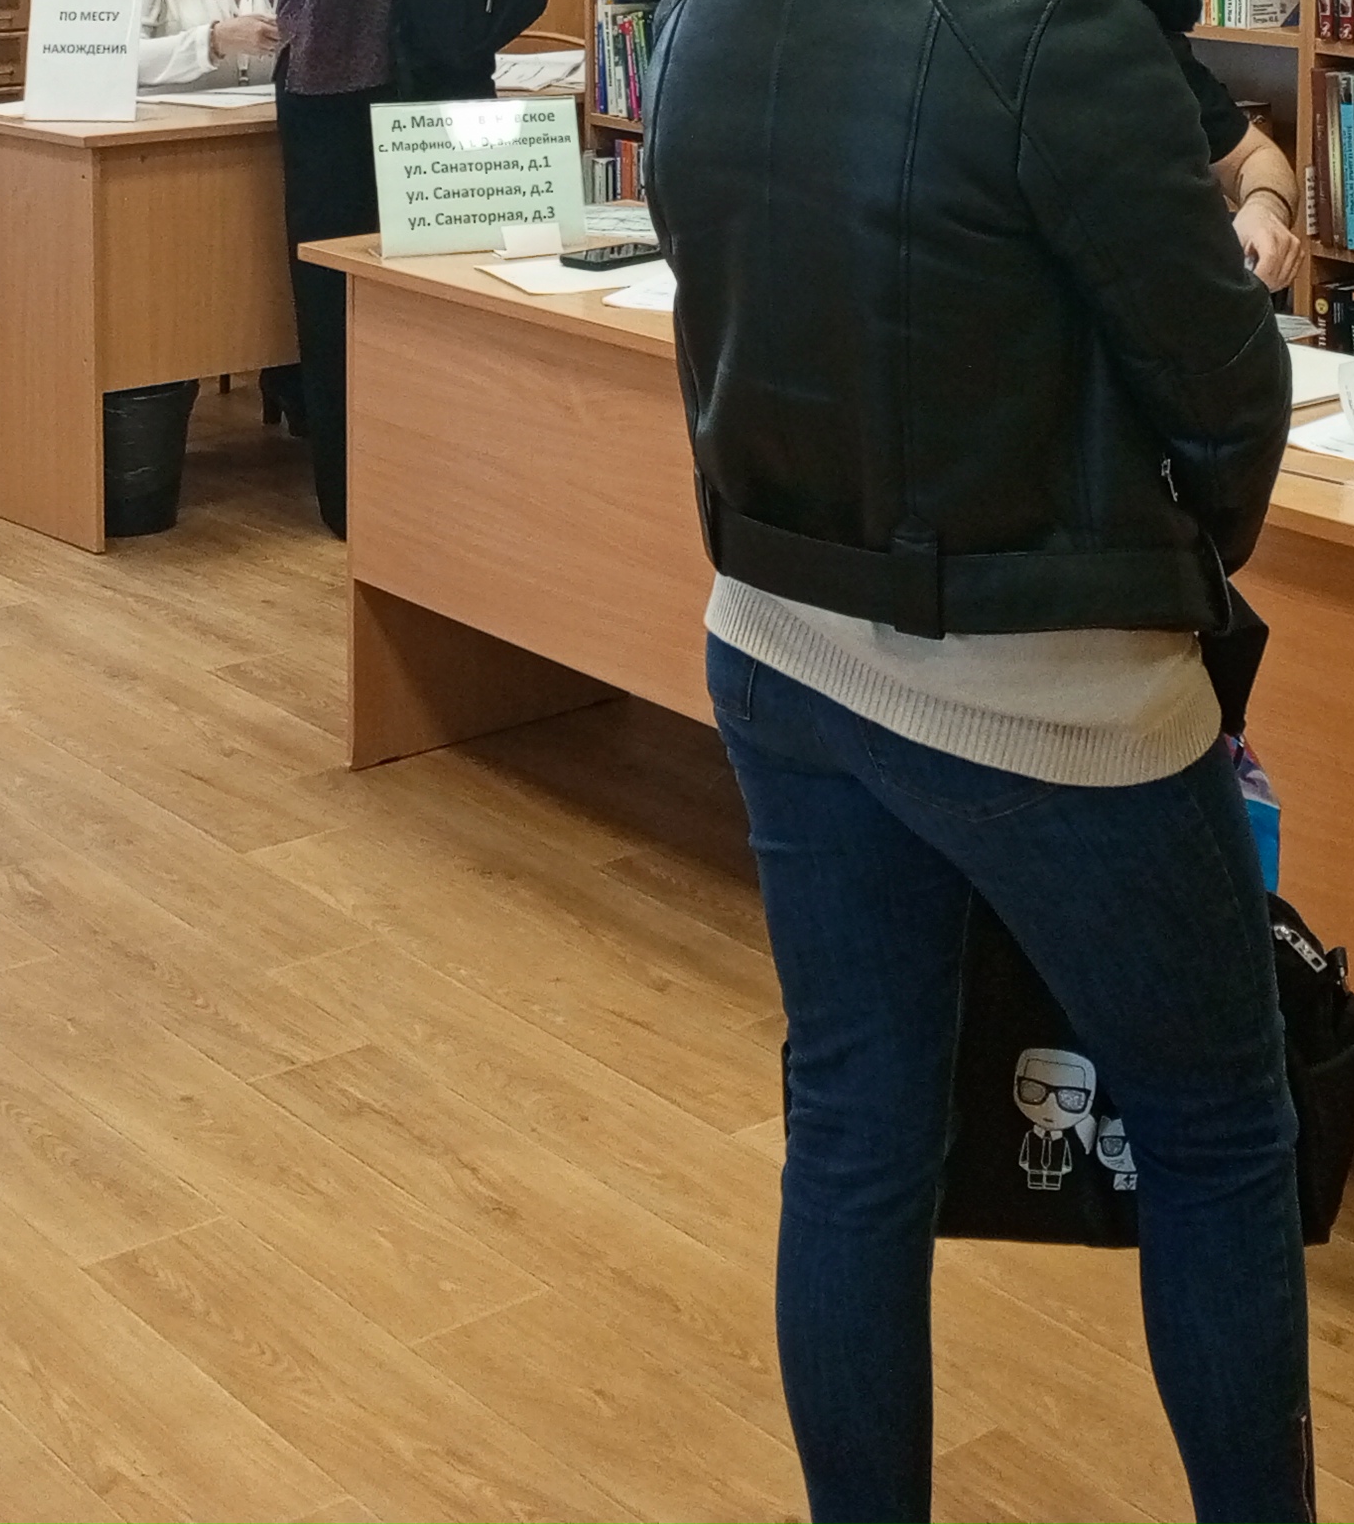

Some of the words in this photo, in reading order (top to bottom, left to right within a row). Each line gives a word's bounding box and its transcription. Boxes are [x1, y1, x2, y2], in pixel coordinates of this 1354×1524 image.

[60, 11, 77, 21] ПО
[80, 11, 120, 21] МЕСТУ
[43, 44, 127, 55] НАХОЖДЕНИЯ
[391, 117, 406, 131] д.
[378, 143, 388, 153] с.
[392, 138, 456, 153] Марфино,
[404, 163, 427, 178] ул.
[431, 157, 524, 176] Санаторная,
[528, 156, 551, 171] д.1
[406, 188, 429, 204] ул.
[433, 183, 526, 201] Санаторная,
[530, 181, 553, 197] д.2
[408, 214, 431, 230] ул.
[435, 209, 528, 226] Санаторная,
[532, 207, 555, 222] д.3
